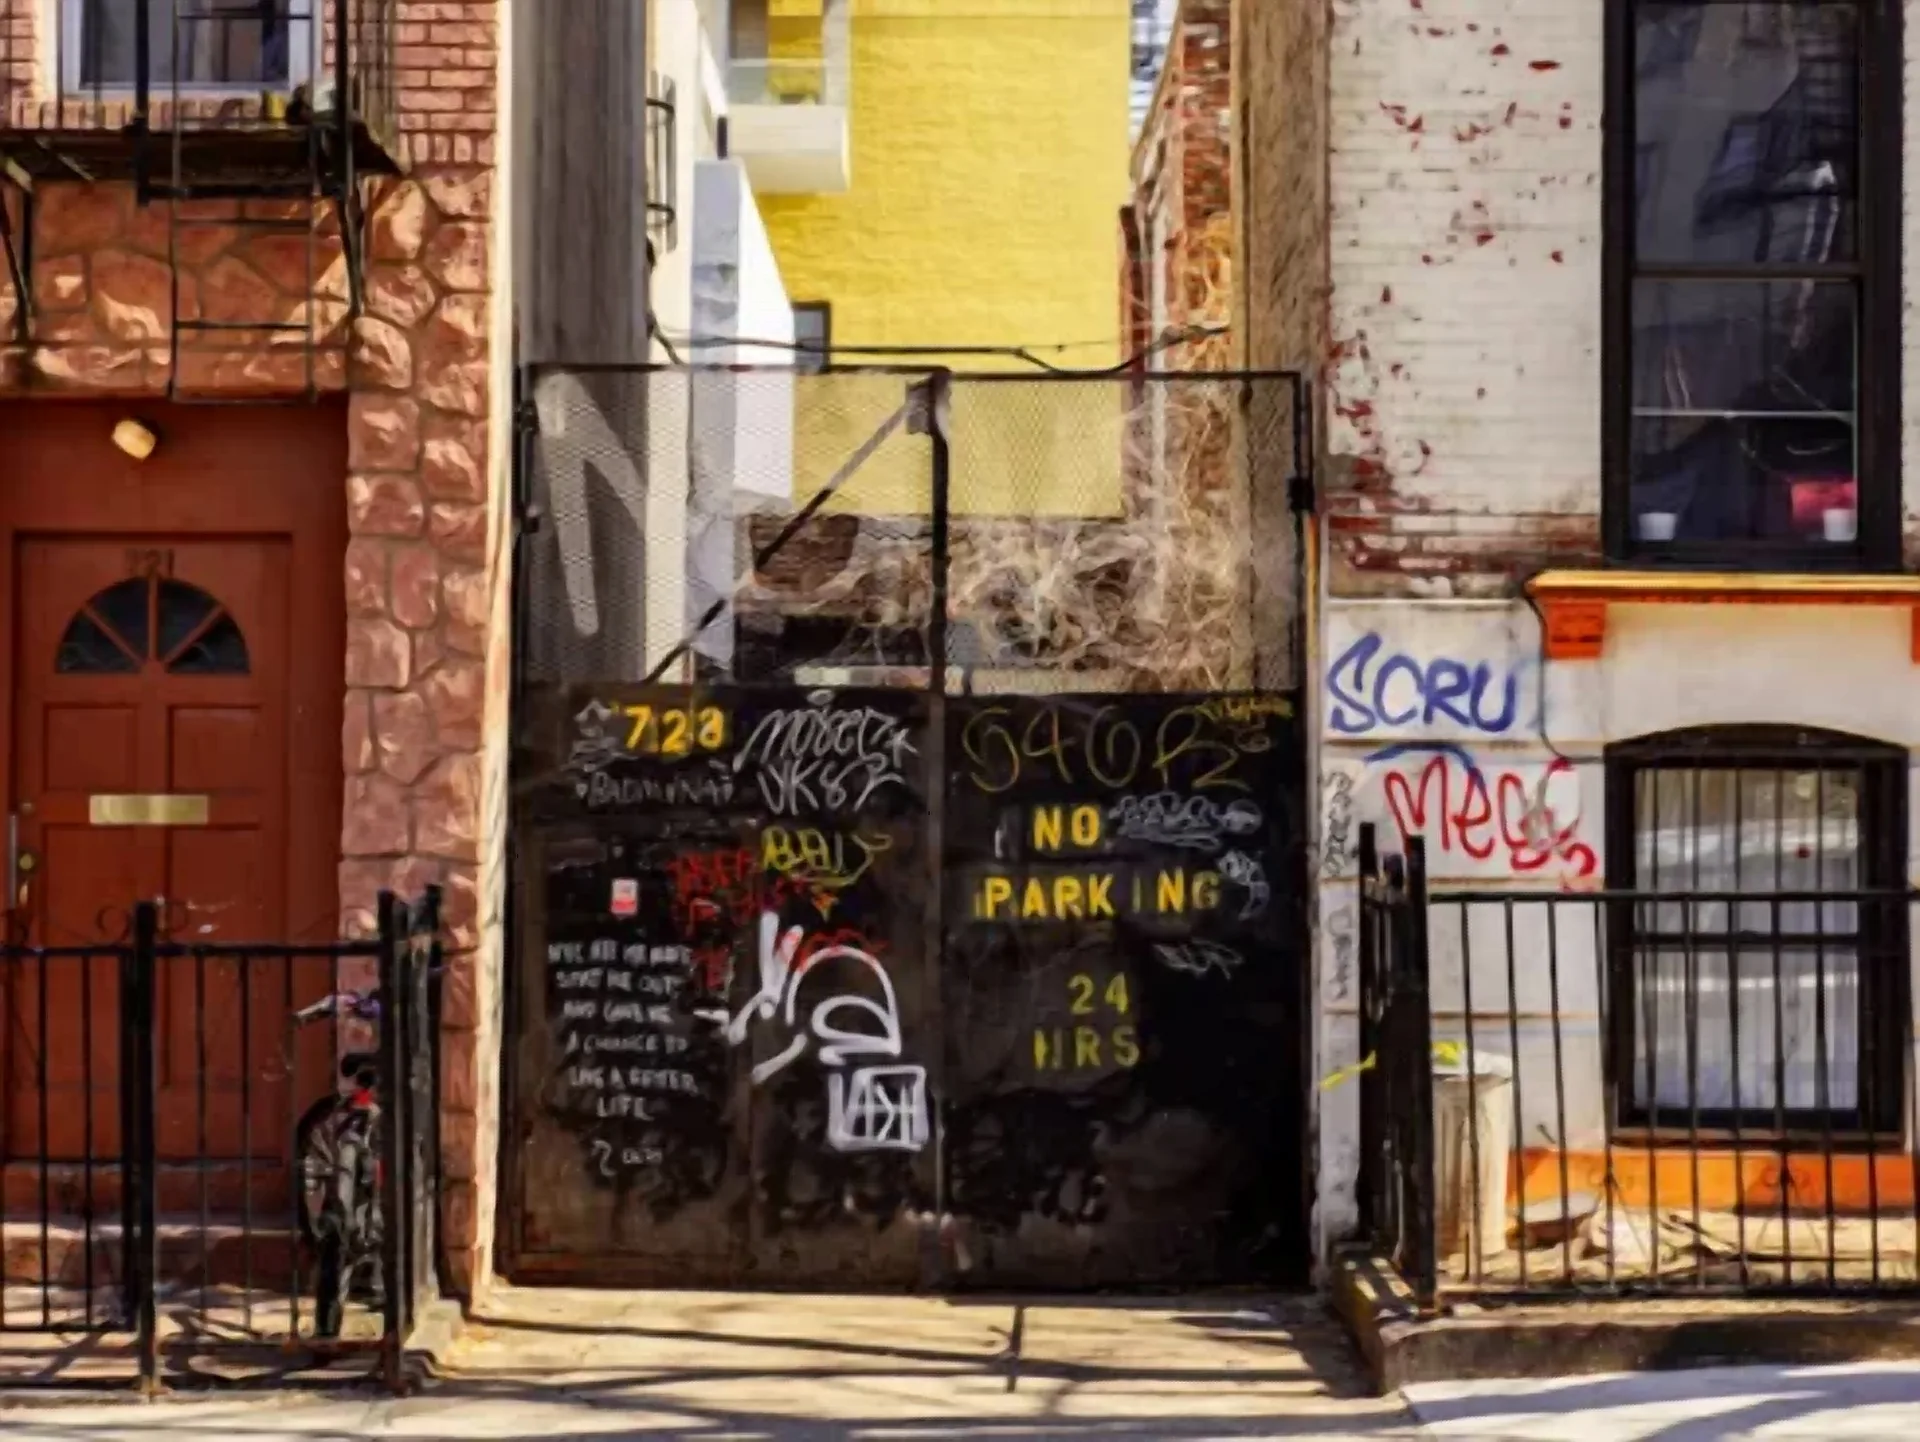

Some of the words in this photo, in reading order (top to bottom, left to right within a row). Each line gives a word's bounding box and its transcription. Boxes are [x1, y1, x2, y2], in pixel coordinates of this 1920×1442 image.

[1033, 803, 1101, 851] NO
[980, 866, 1222, 921] PARKING
[1067, 972, 1129, 1015] 24
